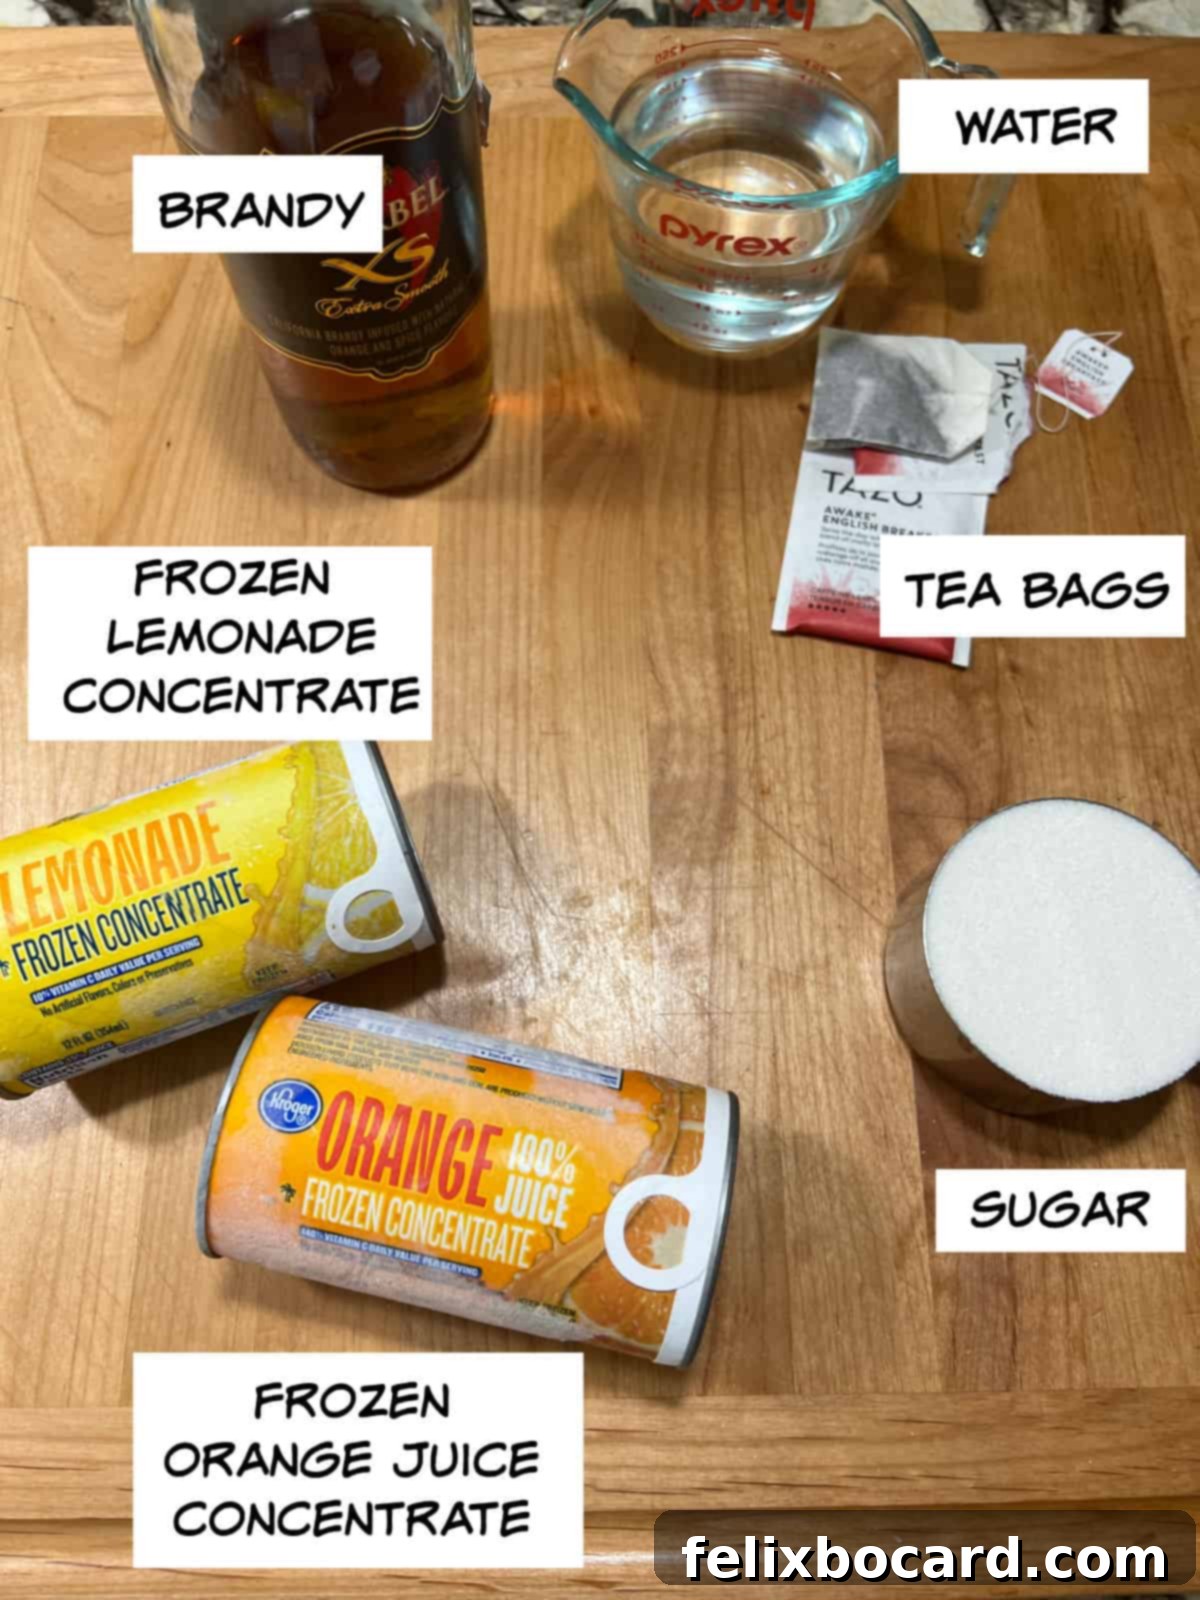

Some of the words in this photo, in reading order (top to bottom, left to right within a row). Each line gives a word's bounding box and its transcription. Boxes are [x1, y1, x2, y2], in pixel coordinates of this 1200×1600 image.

[382, 175, 449, 231] BEL
[320, 232, 435, 292] XS
[659, 214, 798, 256] pyrex
[314, 296, 383, 319] Extra
[384, 256, 449, 312] Smooth
[822, 514, 878, 531] ENGLISH
[0, 800, 231, 937] LEMONADE
[11, 919, 101, 982] FROZEN
[96, 867, 250, 952] CONCENTRATE
[51, 976, 88, 998] VITAMIN
[87, 974, 96, 985] C
[95, 964, 120, 982] DAILY
[119, 957, 147, 975] VALUE
[146, 951, 164, 965] PER
[163, 938, 201, 958] SERVING
[269, 1088, 314, 1123] Kroger
[316, 1090, 503, 1207] ORANGE
[507, 1131, 578, 1184] 100%
[301, 1176, 383, 1236] FROZEN
[384, 1196, 535, 1268] CONCENTRATE
[494, 1174, 575, 1230] JUICE
[324, 1232, 361, 1250] VITAMIN
[394, 1249, 422, 1265] VALUE
[440, 1260, 479, 1278] SERVING
